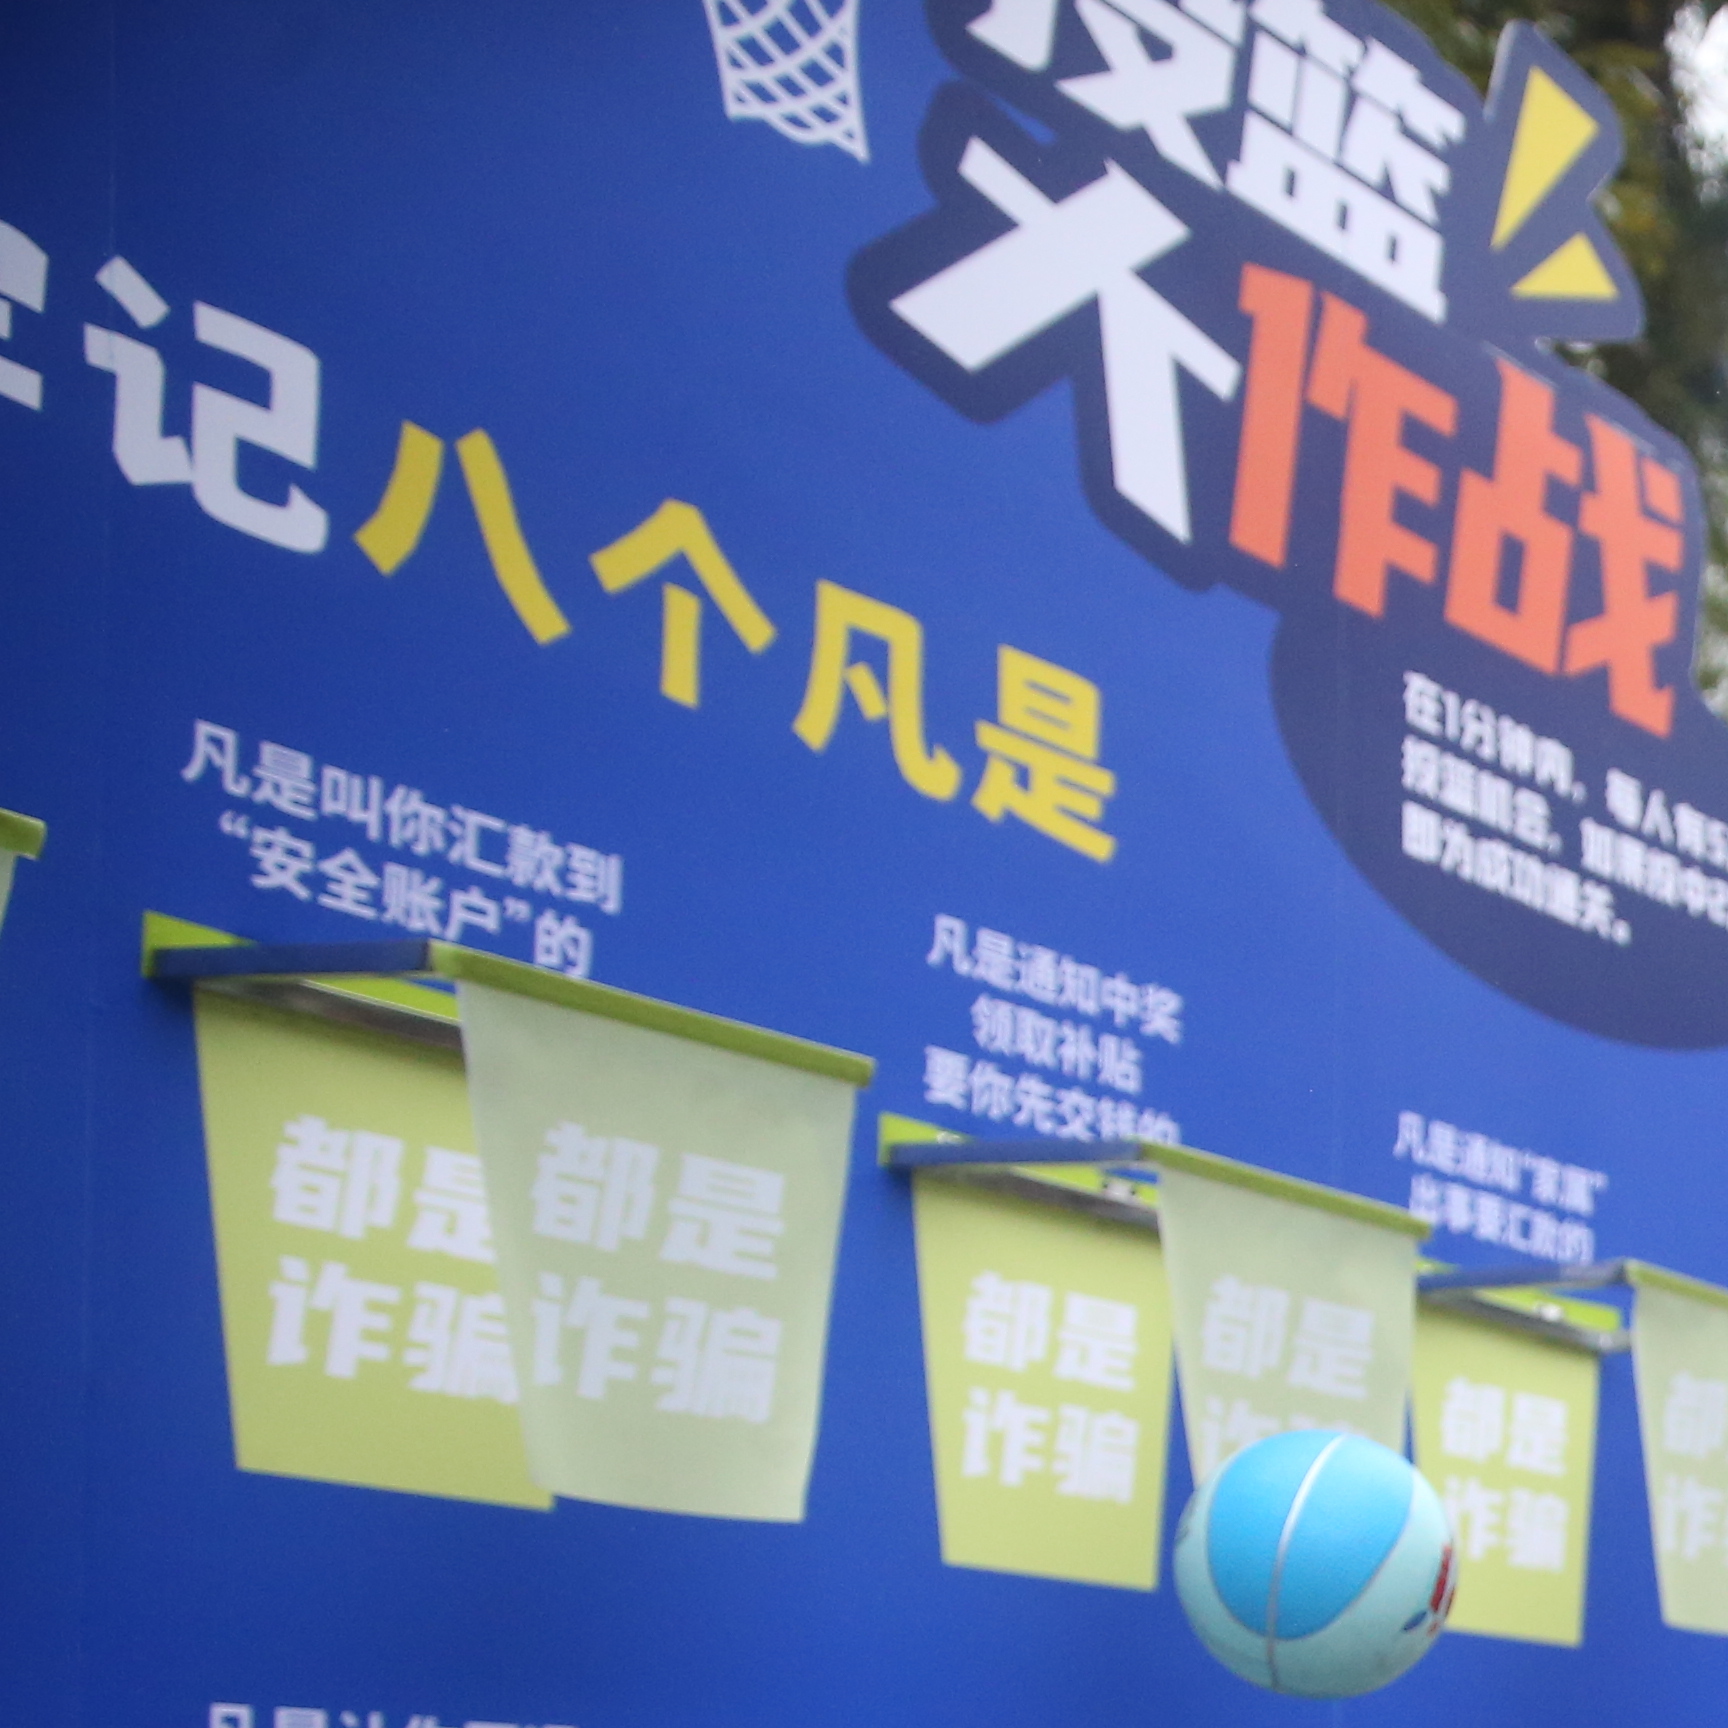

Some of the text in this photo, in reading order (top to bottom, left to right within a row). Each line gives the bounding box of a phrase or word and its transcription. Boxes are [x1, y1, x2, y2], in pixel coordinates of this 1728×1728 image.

[889, 135, 1683, 739] 大作战
[0, 219, 1117, 864] 记八个凡是
[181, 718, 624, 914] 凡是叫你汇款到
[218, 811, 593, 979] “安全账户”的
[926, 913, 1183, 1046] 凡是通知中奖
[970, 993, 1142, 1097] 领取补贴
[269, 1114, 496, 1266] 都是
[530, 1120, 787, 1281] 都是
[266, 1254, 521, 1406] 诈骗
[530, 1271, 784, 1425] 诈骗
[961, 1270, 1141, 1392] 都是
[1200, 1274, 1376, 1400] 都是
[959, 1386, 1141, 1506] 诈骗
[1440, 1375, 1568, 1478] 都是
[1442, 1475, 1570, 1574] 诈骗
